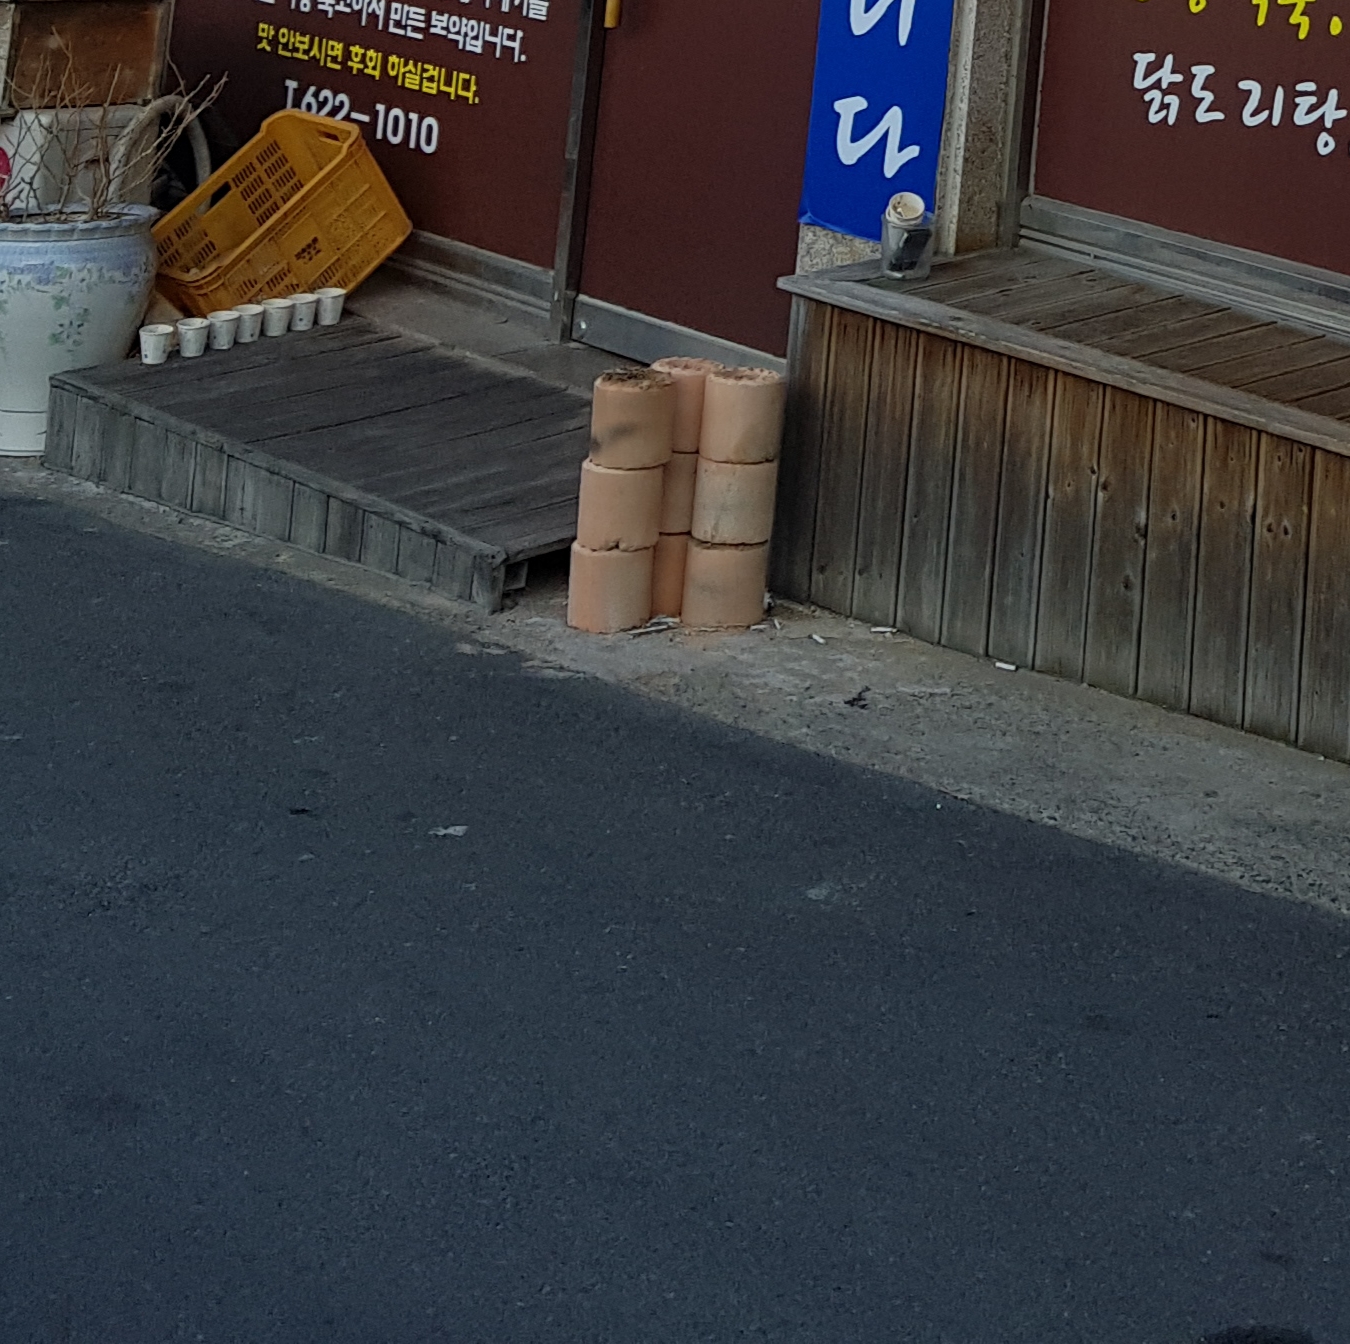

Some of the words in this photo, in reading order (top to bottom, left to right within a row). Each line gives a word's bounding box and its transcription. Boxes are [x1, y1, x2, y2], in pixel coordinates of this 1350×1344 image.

[256, 22, 275, 52] 맛
[278, 26, 344, 70] 안보시면
[347, 44, 383, 81] 후회
[387, 53, 480, 104] 하실겁니다.
[388, 1, 427, 40] 만든
[429, 10, 527, 63] 보약입니다.
